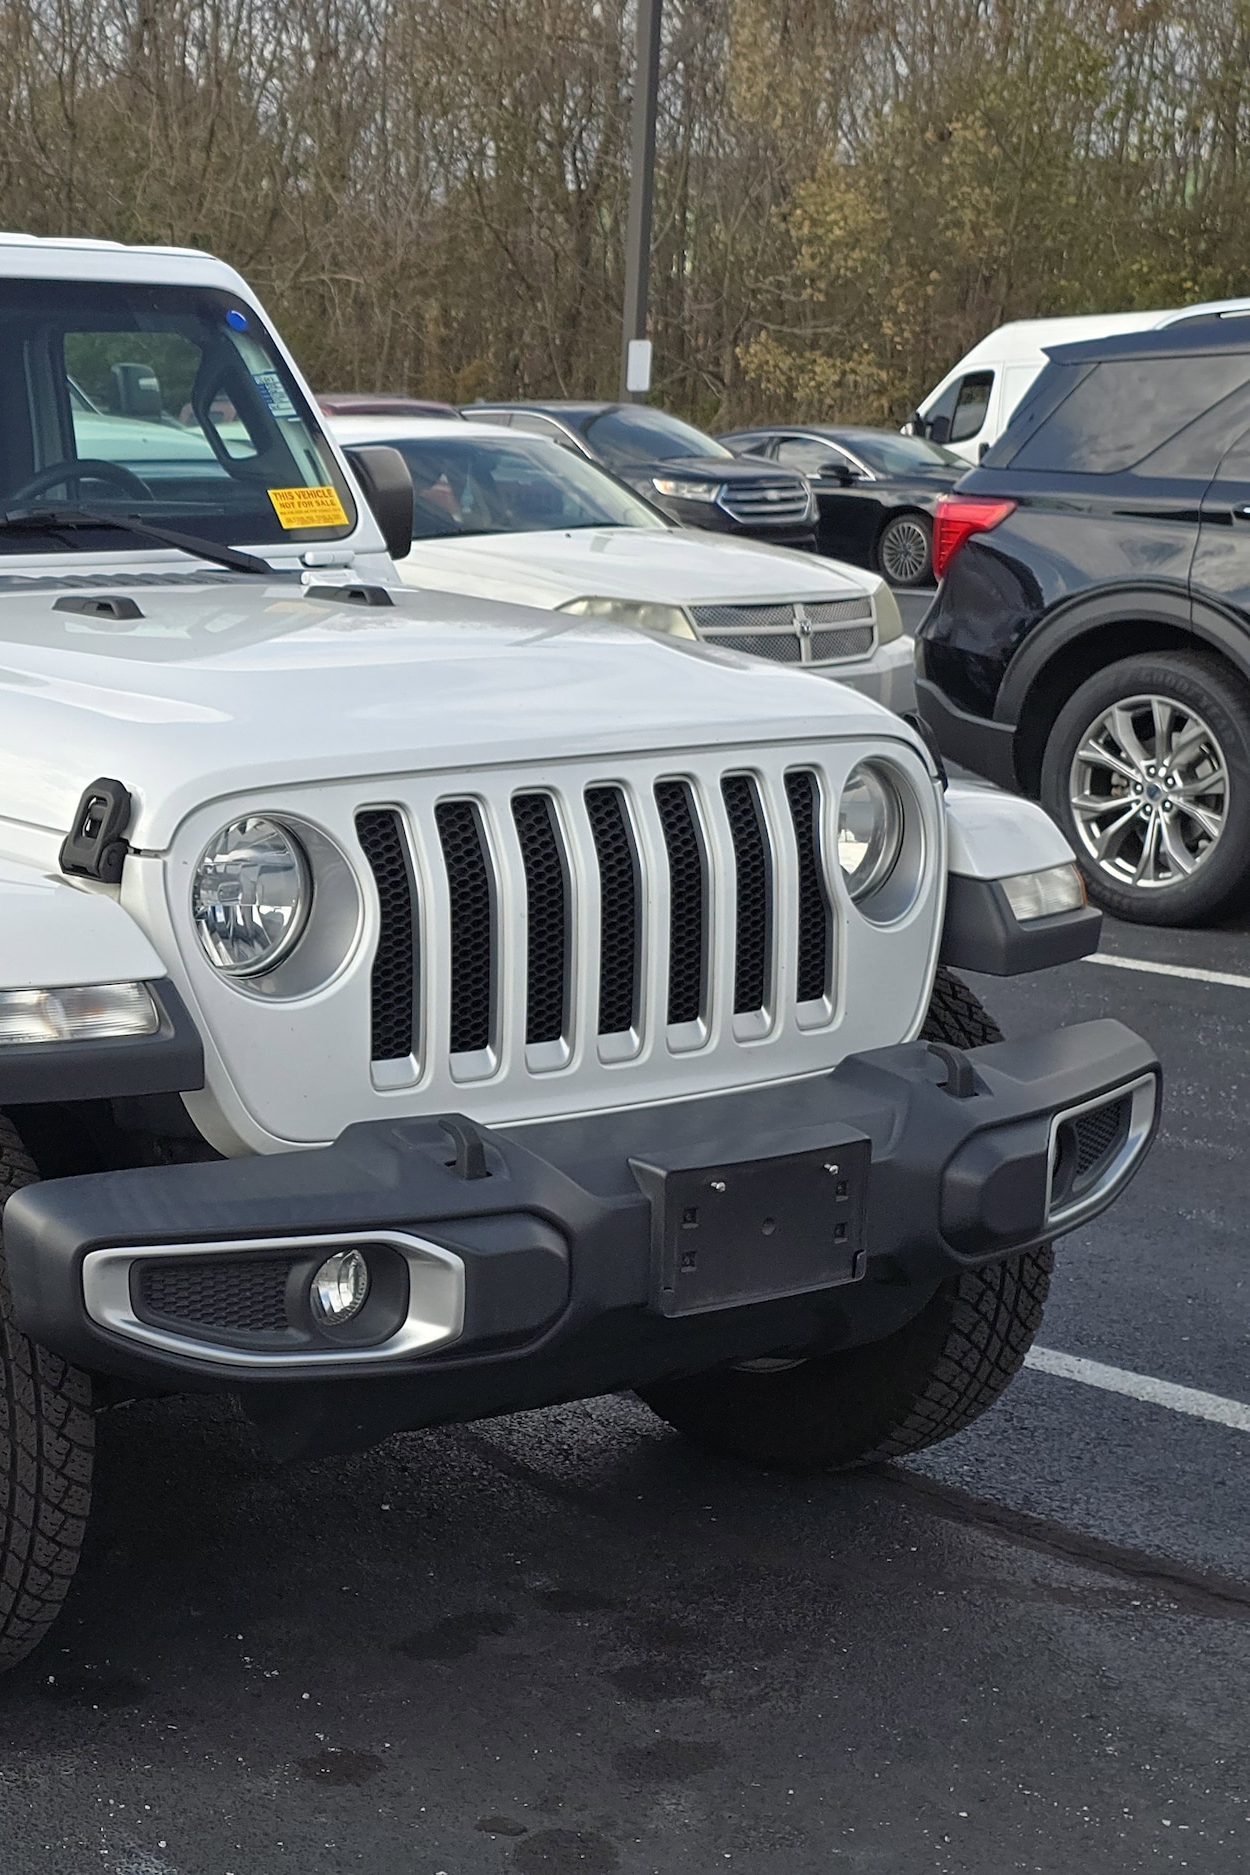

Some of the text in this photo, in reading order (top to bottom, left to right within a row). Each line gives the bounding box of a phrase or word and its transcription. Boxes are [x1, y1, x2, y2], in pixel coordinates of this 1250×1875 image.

[273, 489, 334, 501] THIS VEHICLE
[279, 498, 336, 509] NOT FOR SALE
